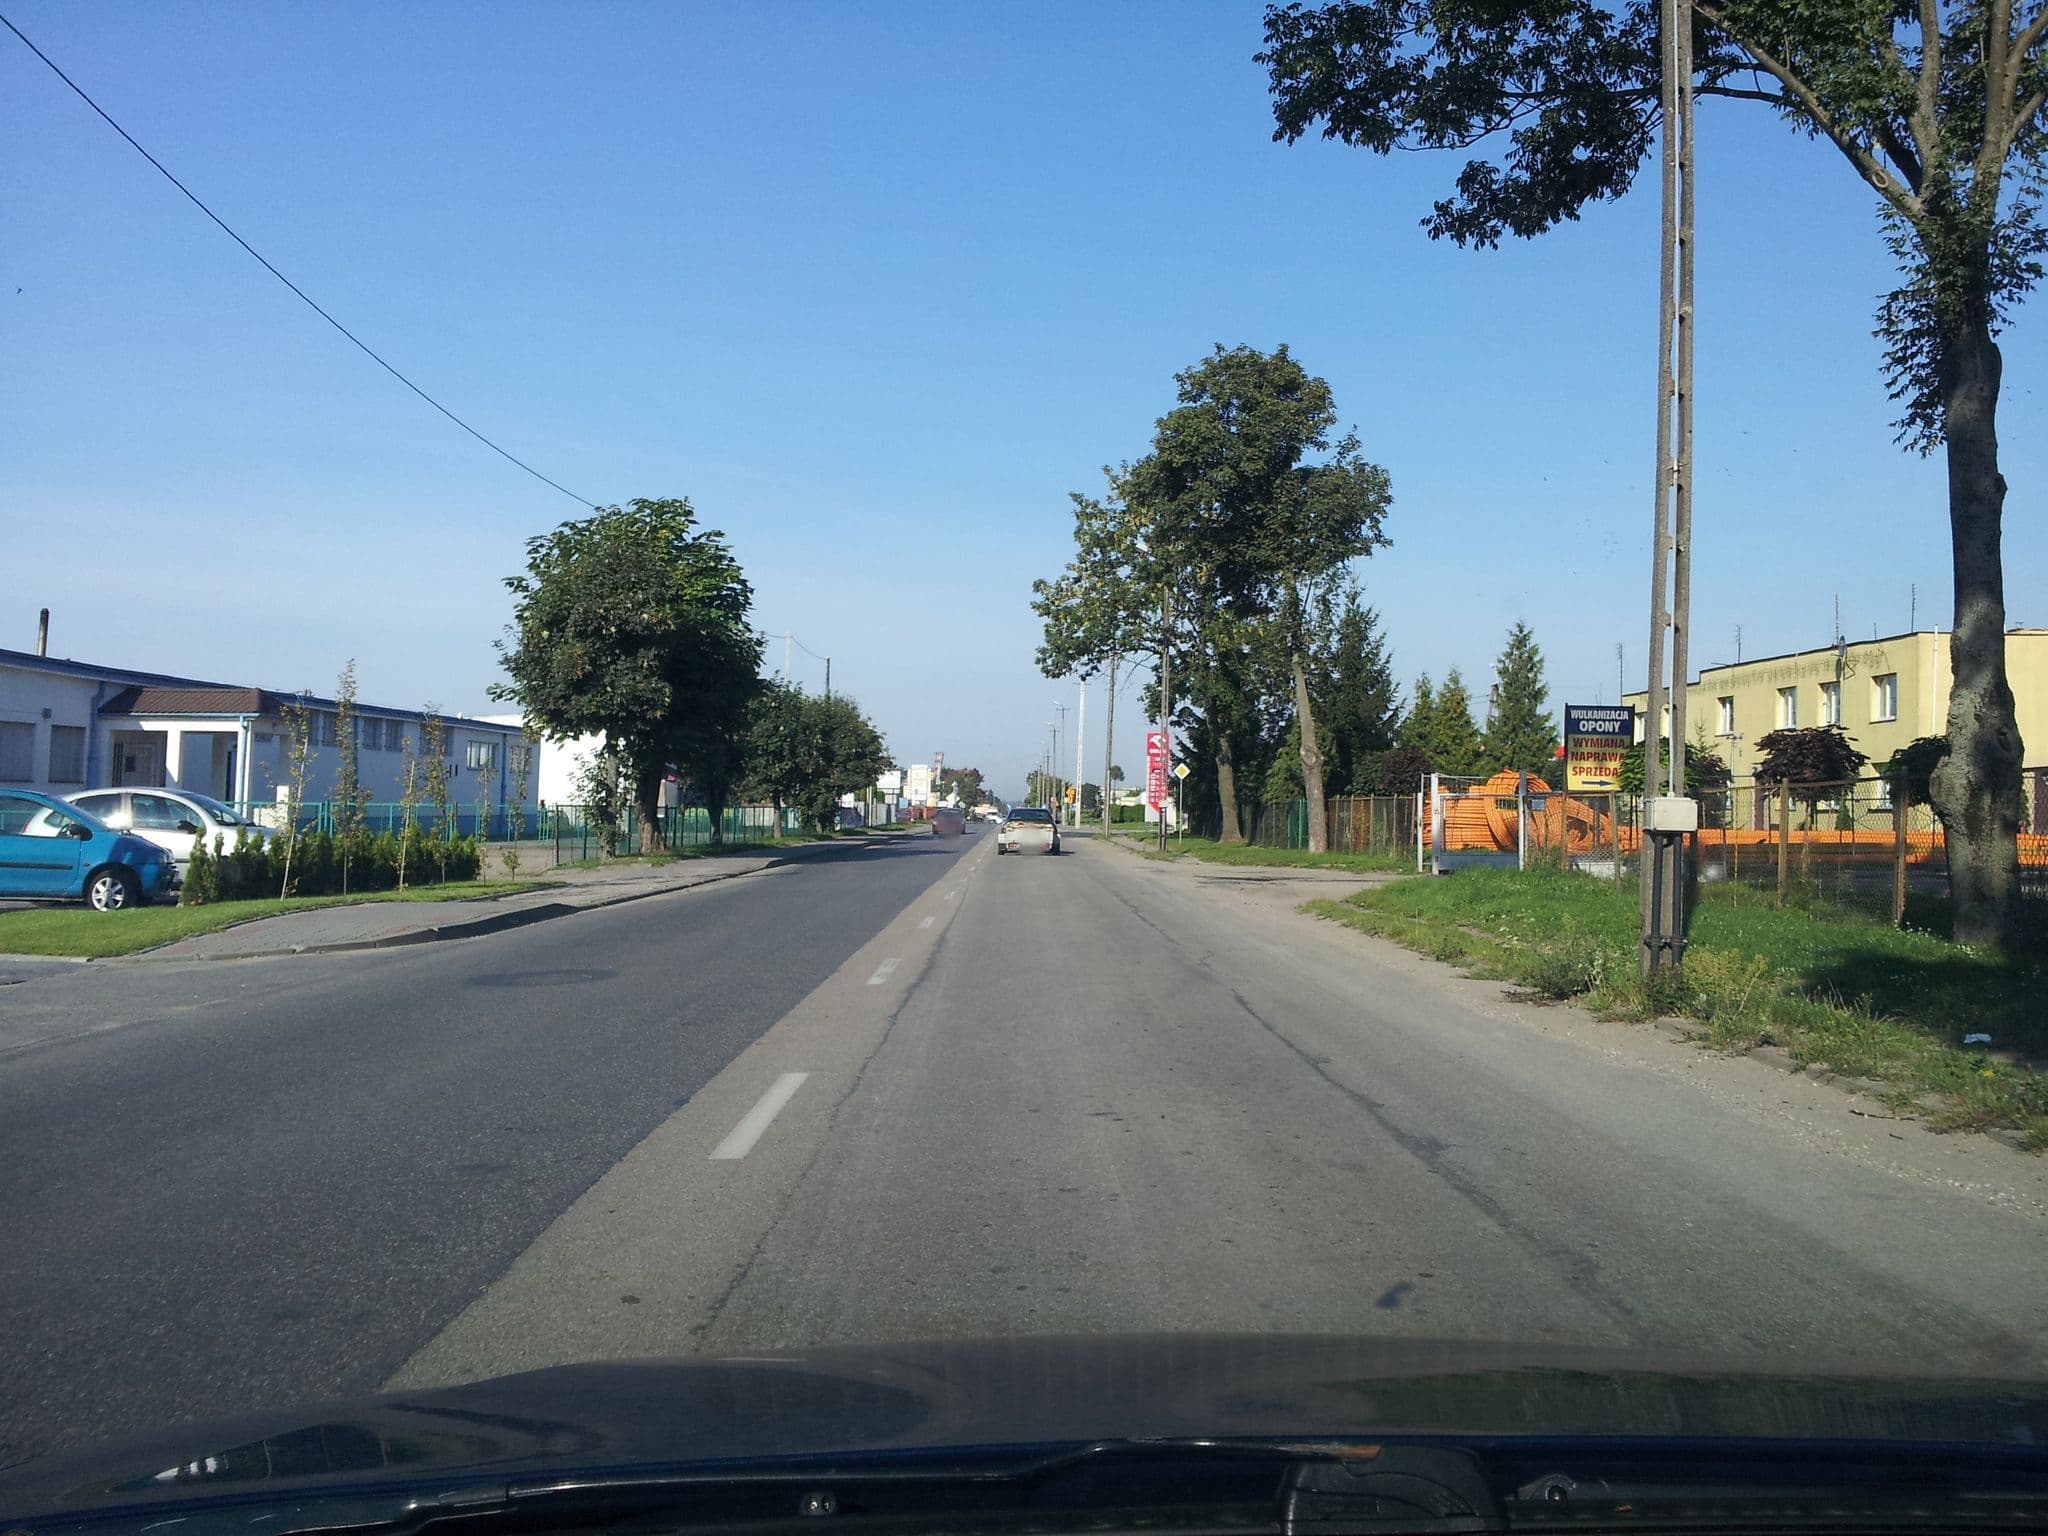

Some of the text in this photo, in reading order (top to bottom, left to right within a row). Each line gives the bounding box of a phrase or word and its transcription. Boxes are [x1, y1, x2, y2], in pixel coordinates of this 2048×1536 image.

[1570, 709, 1629, 720] WULKANIZACJA
[1579, 720, 1621, 732] OPONY
[1573, 737, 1625, 749] WYMIANA
[1572, 766, 1622, 777] SPRZEDA
